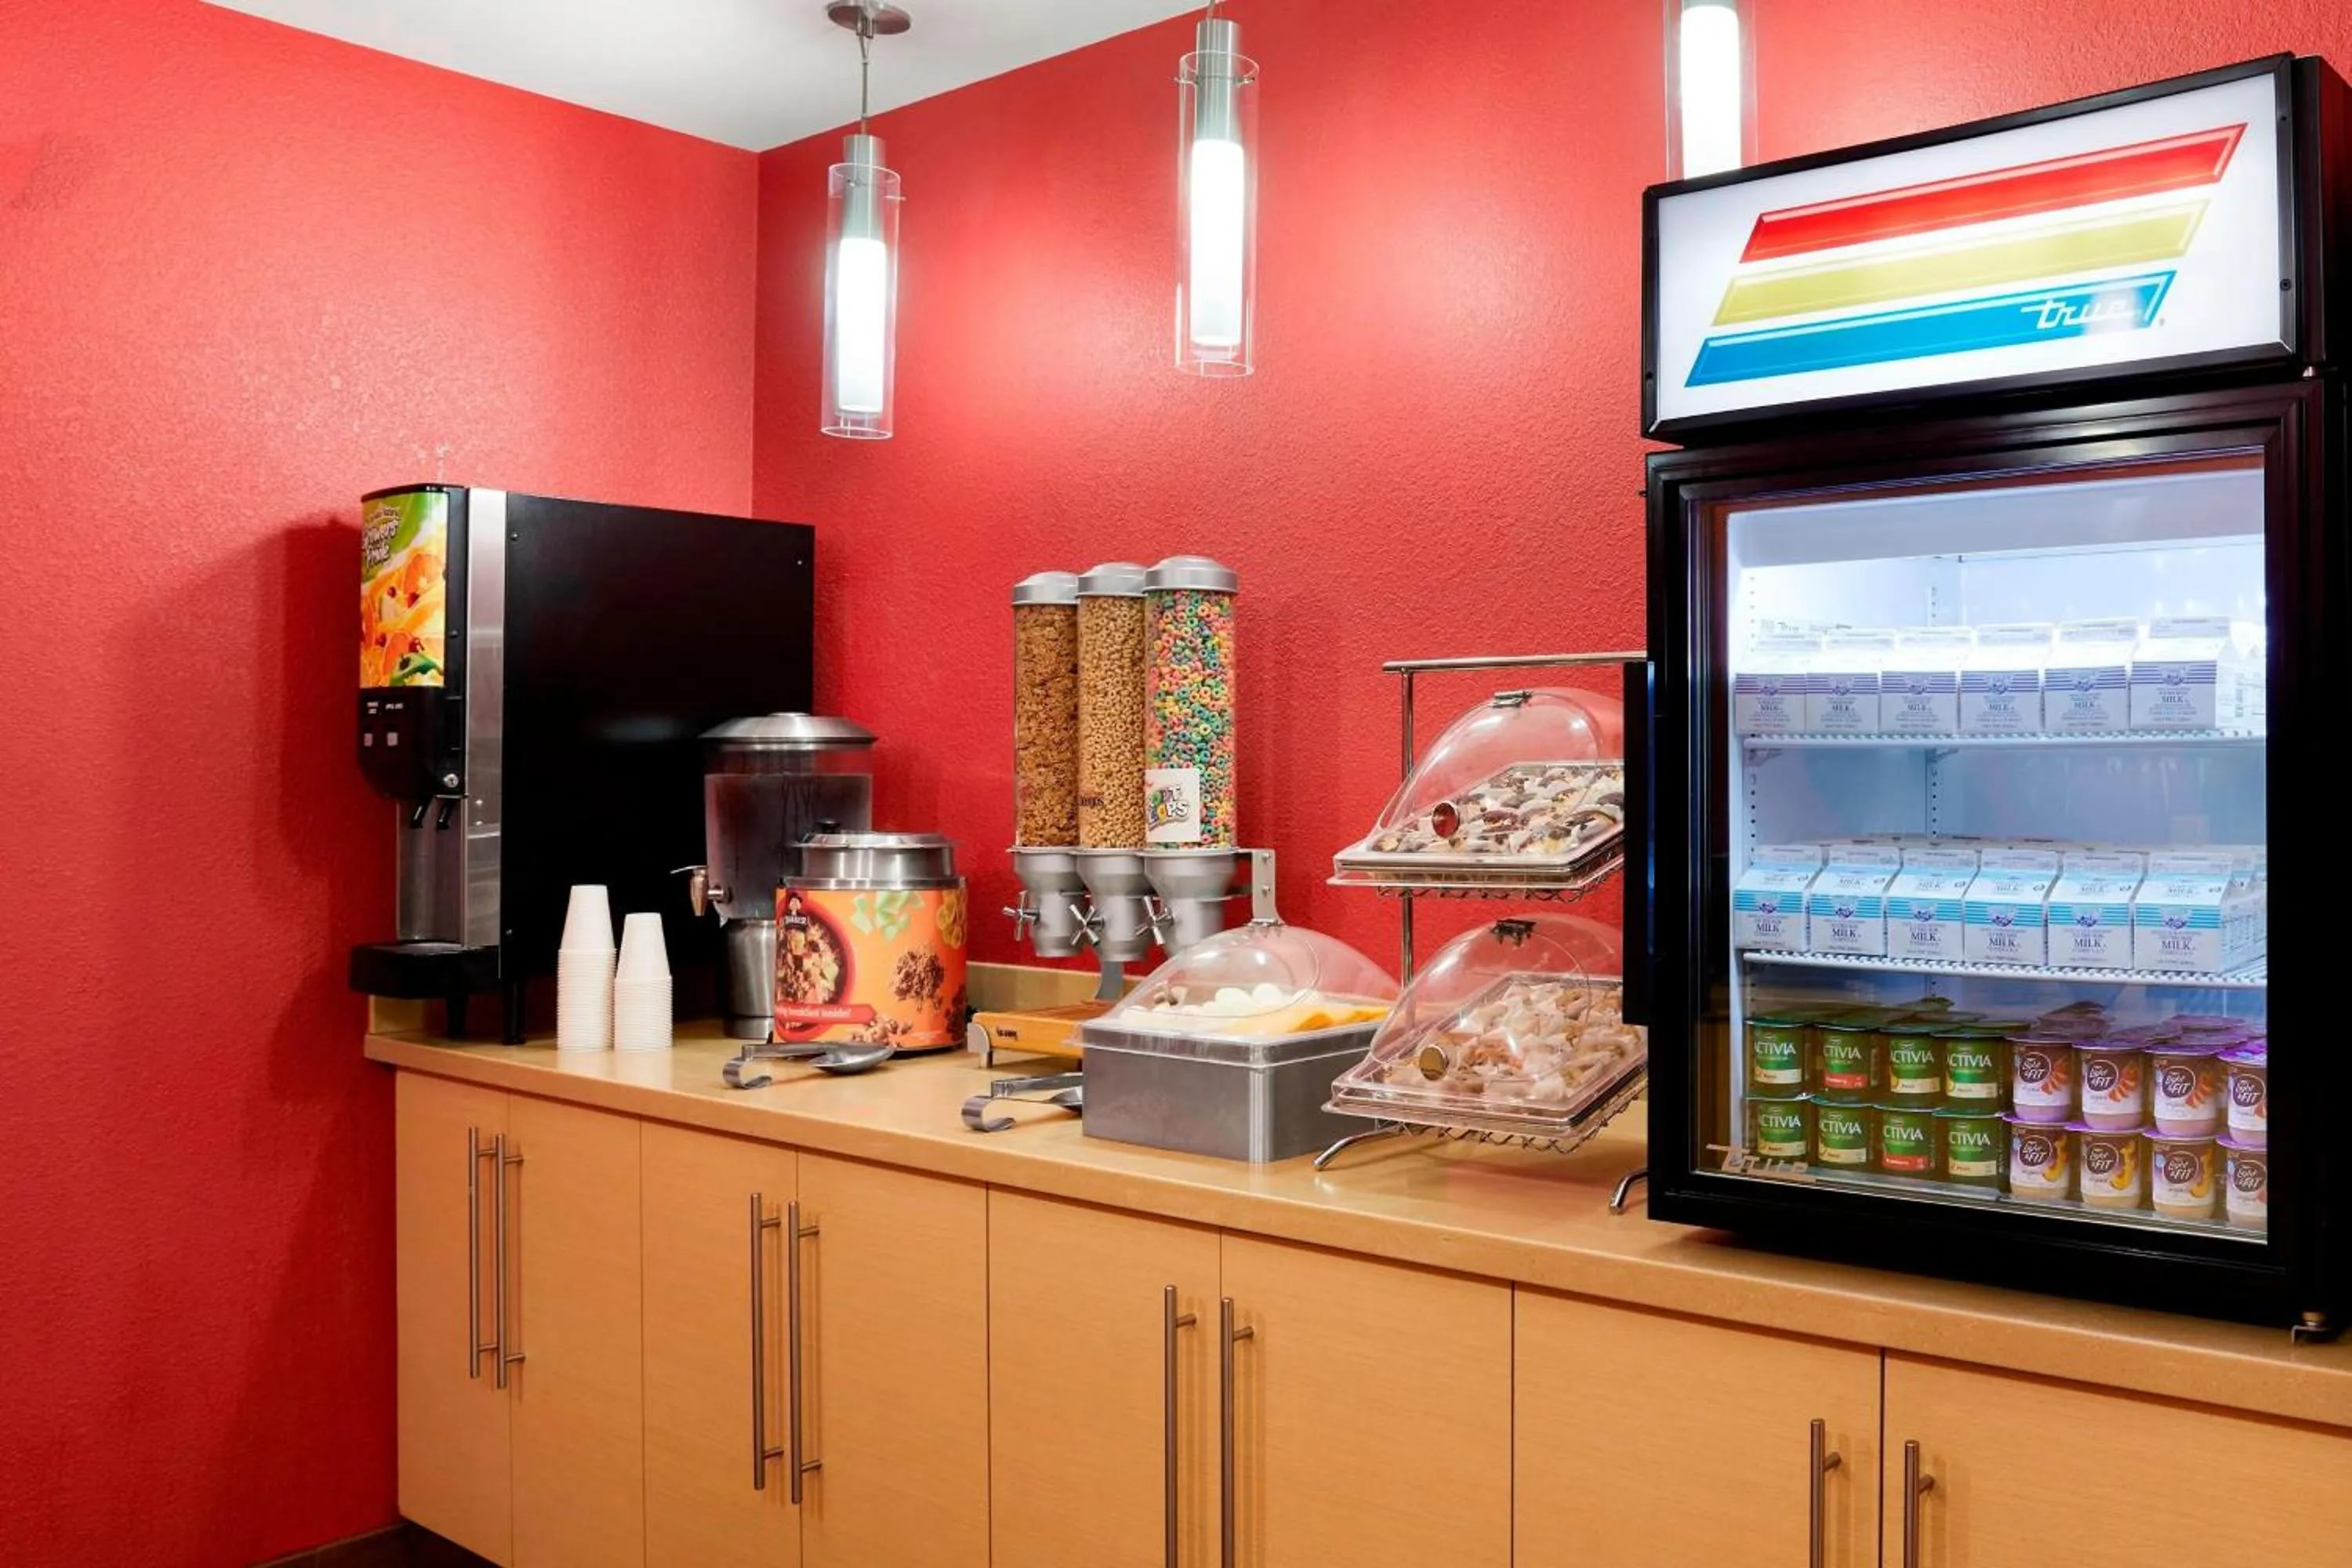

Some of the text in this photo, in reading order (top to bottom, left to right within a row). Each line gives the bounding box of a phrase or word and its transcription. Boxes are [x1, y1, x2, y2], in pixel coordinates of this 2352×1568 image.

[1756, 923, 1779, 932] MILK
[1832, 928, 1857, 937] MILK
[1911, 932, 1936, 941] MILK
[1989, 938, 2016, 946] MILK
[2074, 938, 2102, 948] MILK
[2161, 940, 2190, 950] MILK
[1824, 1045, 1862, 1059] CTIVIA
[1761, 1114, 1802, 1127] CTIVIA
[1820, 1120, 1862, 1134] CTIVIA
[1883, 1126, 1923, 1140] CTIVIA
[1950, 1132, 1991, 1145] CTIVIA
